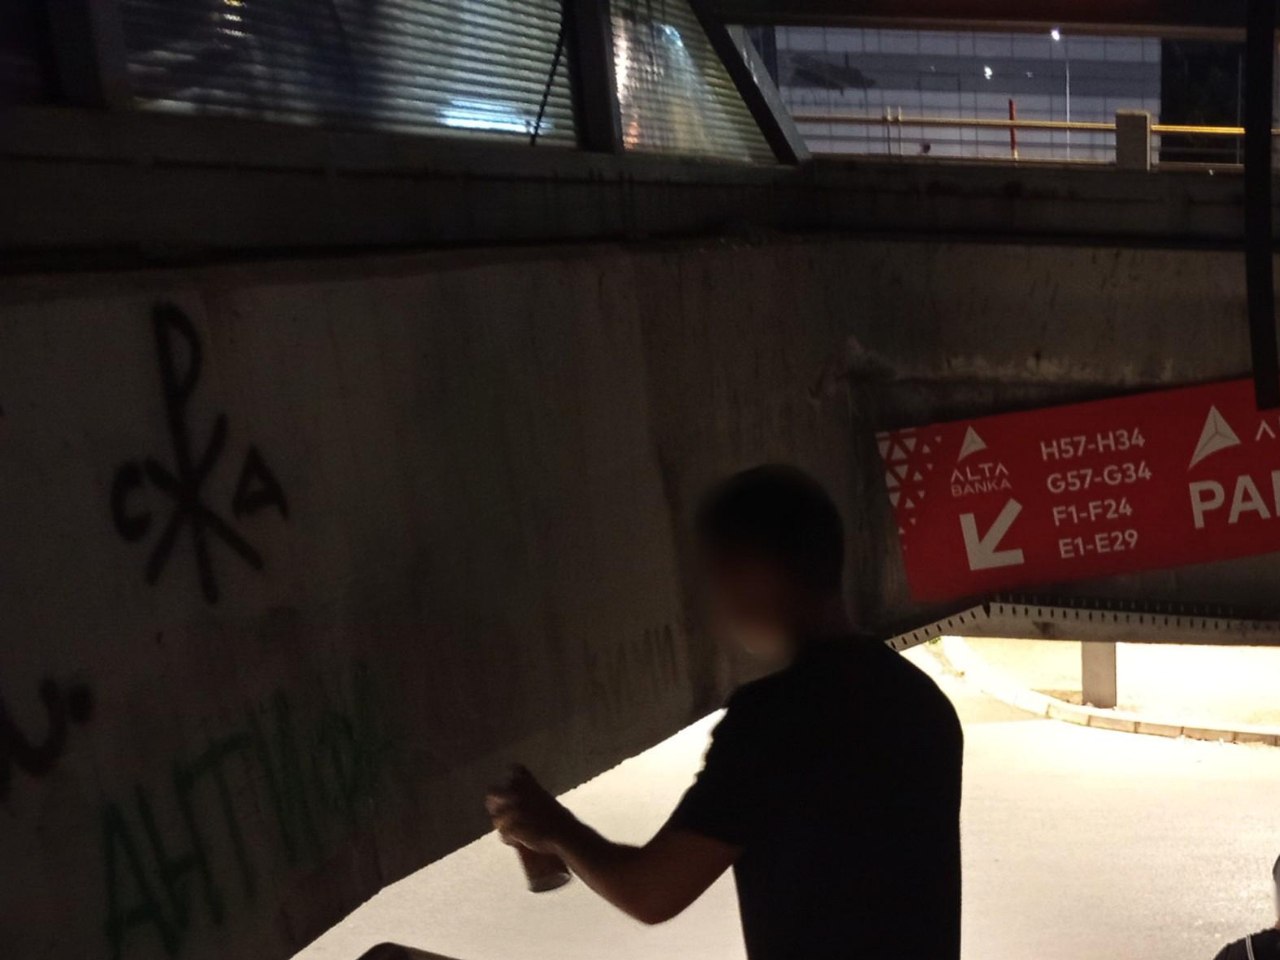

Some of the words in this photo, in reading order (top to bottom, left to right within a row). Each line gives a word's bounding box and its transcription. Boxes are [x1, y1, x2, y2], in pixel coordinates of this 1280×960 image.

[1040, 427, 1146, 461] H57-H34
[950, 462, 1010, 484] ALTA
[1046, 461, 1152, 494] G57-G34
[951, 479, 1012, 498] BANKA
[1052, 497, 1133, 527] F1-F24
[1058, 529, 1139, 559] E1-E29
